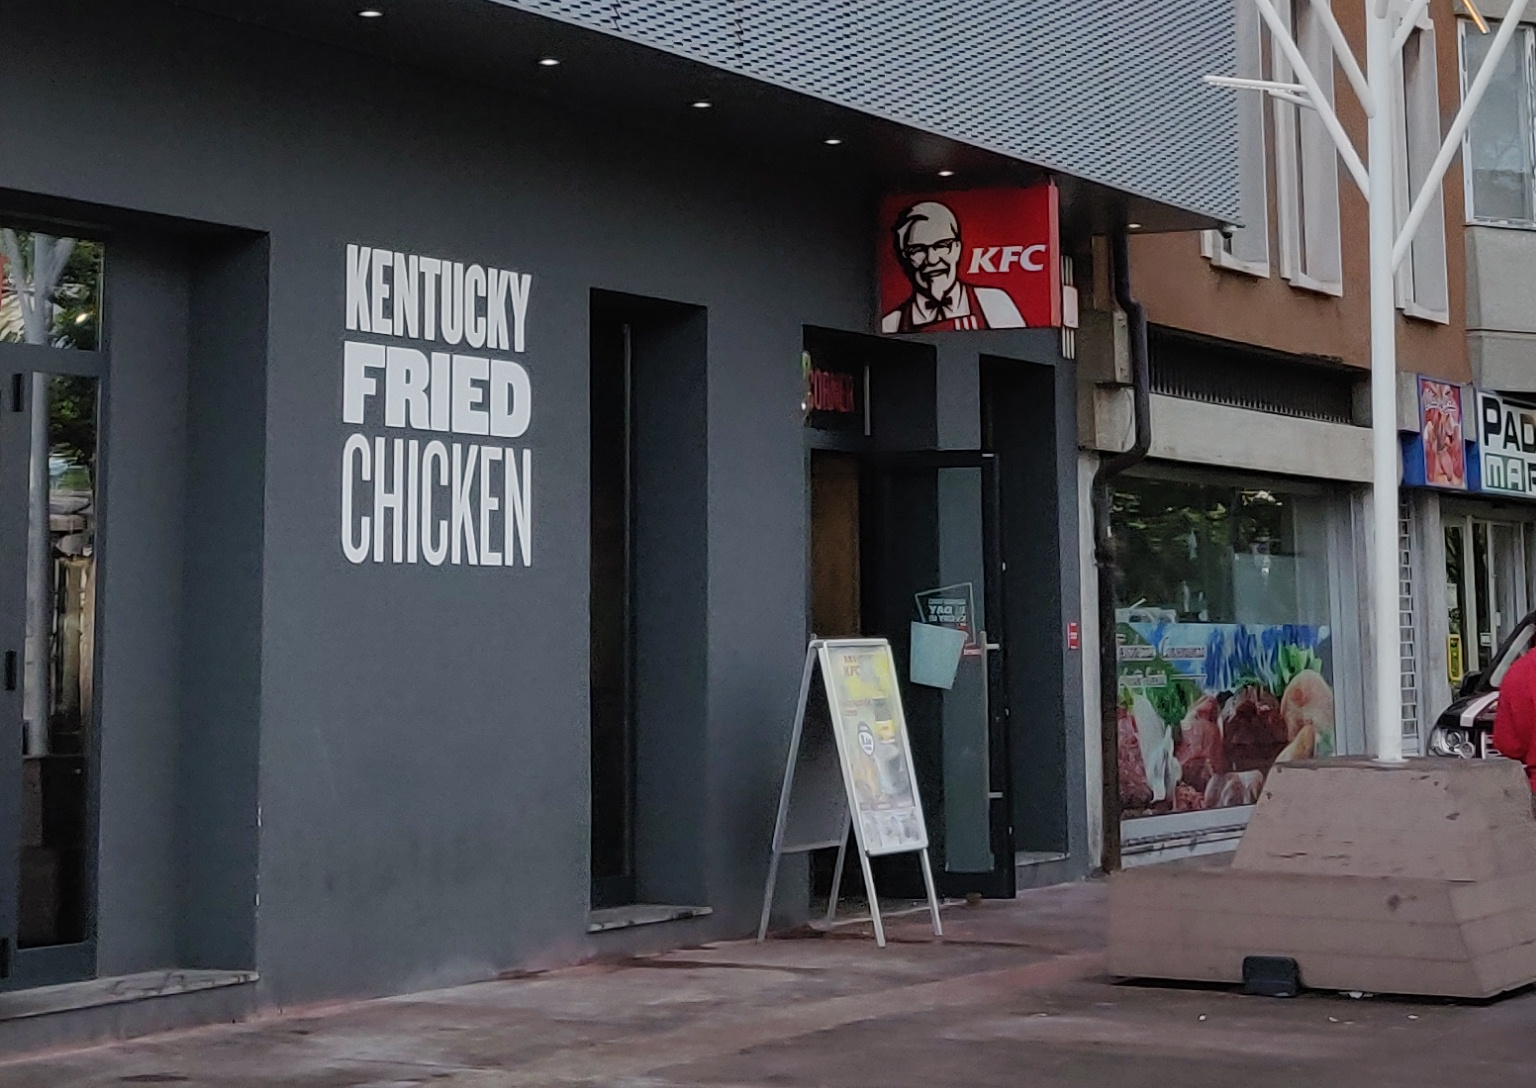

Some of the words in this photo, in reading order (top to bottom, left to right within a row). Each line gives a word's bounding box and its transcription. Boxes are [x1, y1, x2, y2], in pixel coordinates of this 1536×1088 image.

[345, 243, 532, 352] KENTUCKY
[967, 244, 1046, 274] KFC
[343, 340, 532, 438] FRIED
[341, 433, 532, 567] CHICKEN
